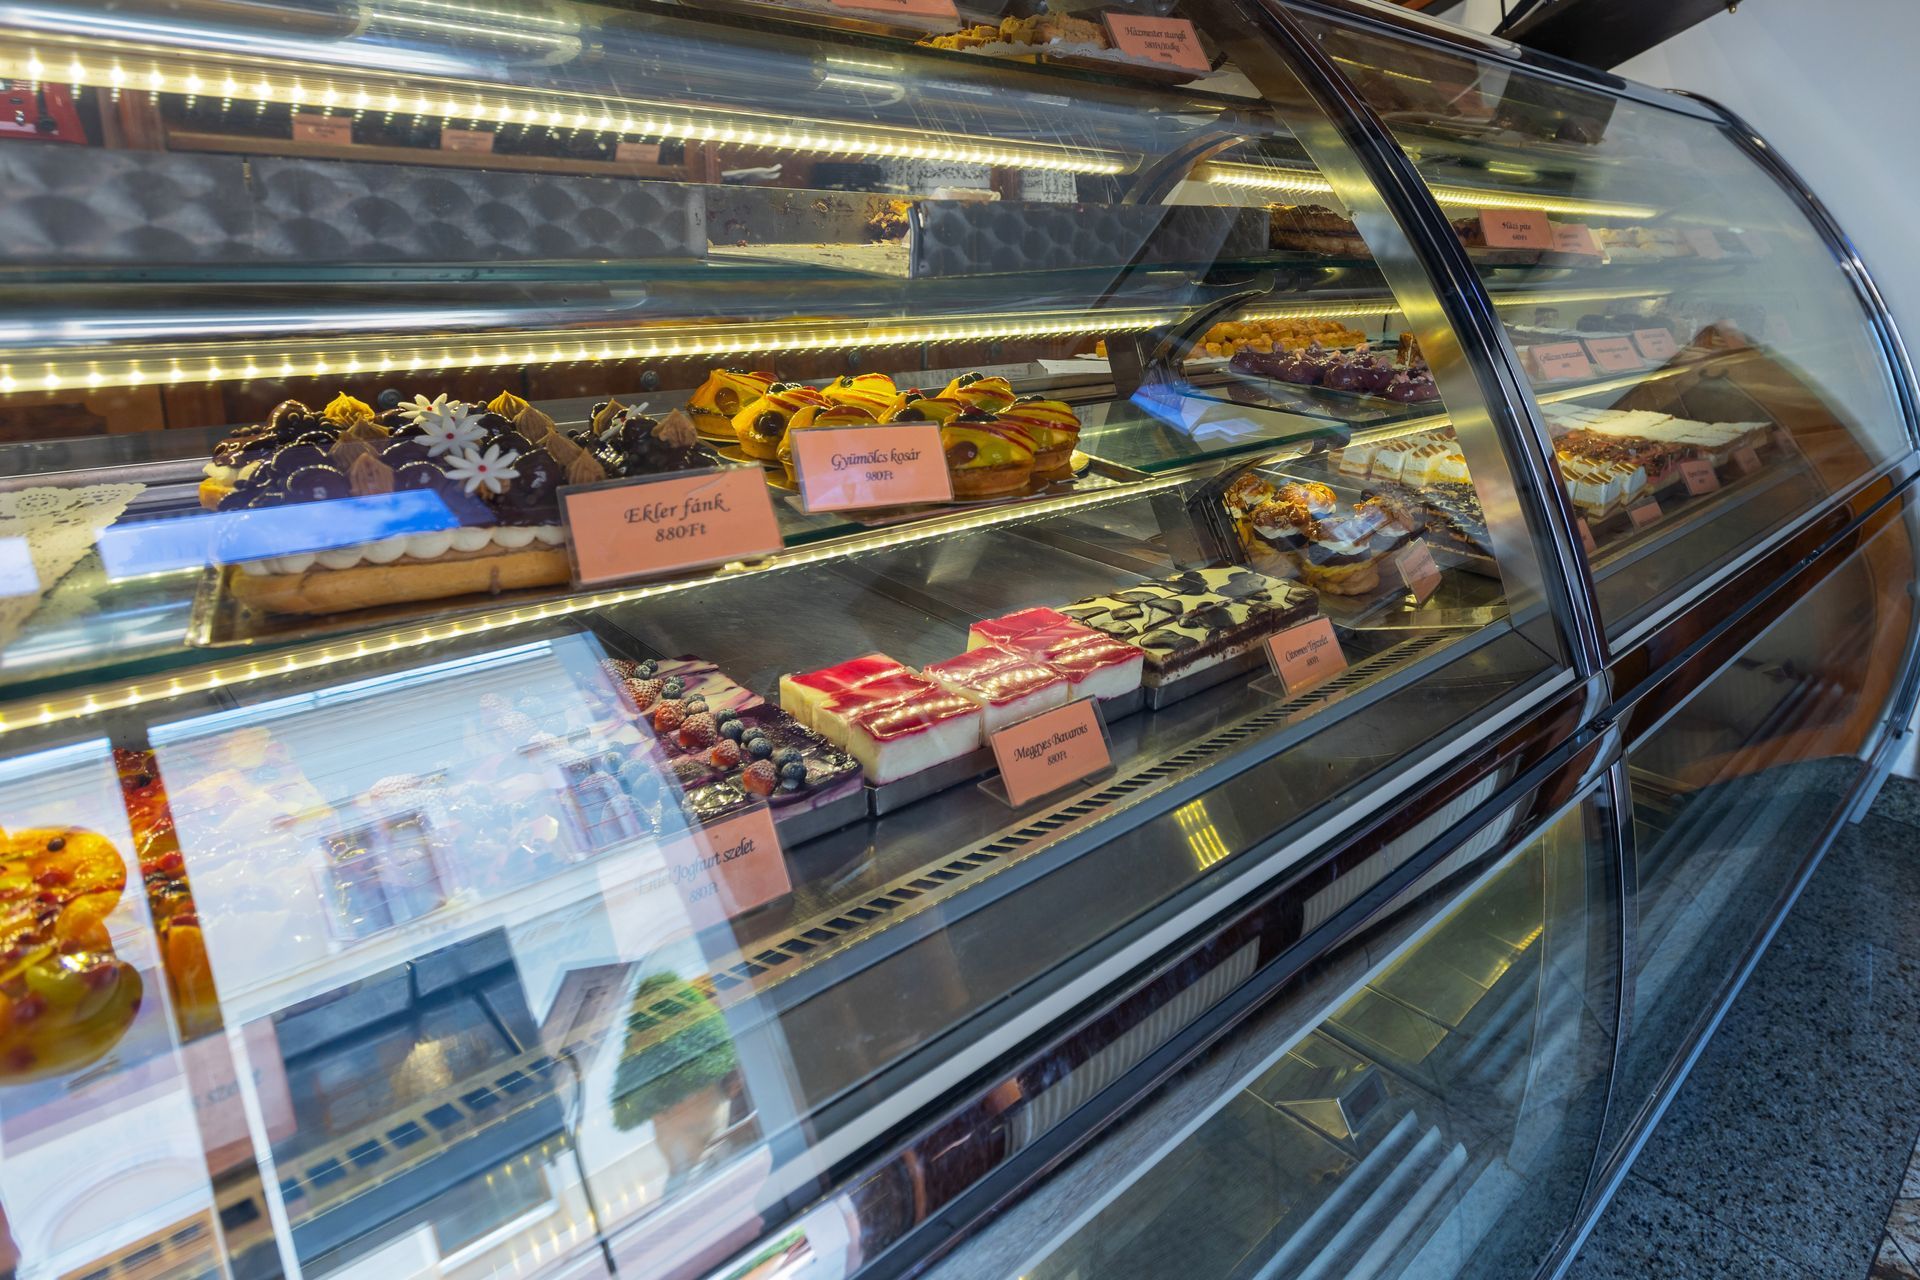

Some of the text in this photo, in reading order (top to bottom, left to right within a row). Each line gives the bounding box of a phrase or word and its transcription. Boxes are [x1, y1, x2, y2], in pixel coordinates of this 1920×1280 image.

[831, 447, 921, 471] Gyümölcs kosár
[623, 492, 731, 524] Ekler fánk
[1013, 722, 1089, 762] Meggyes Bavarois
[671, 851, 723, 887] Joghurt
[722, 836, 757, 864] szelet
